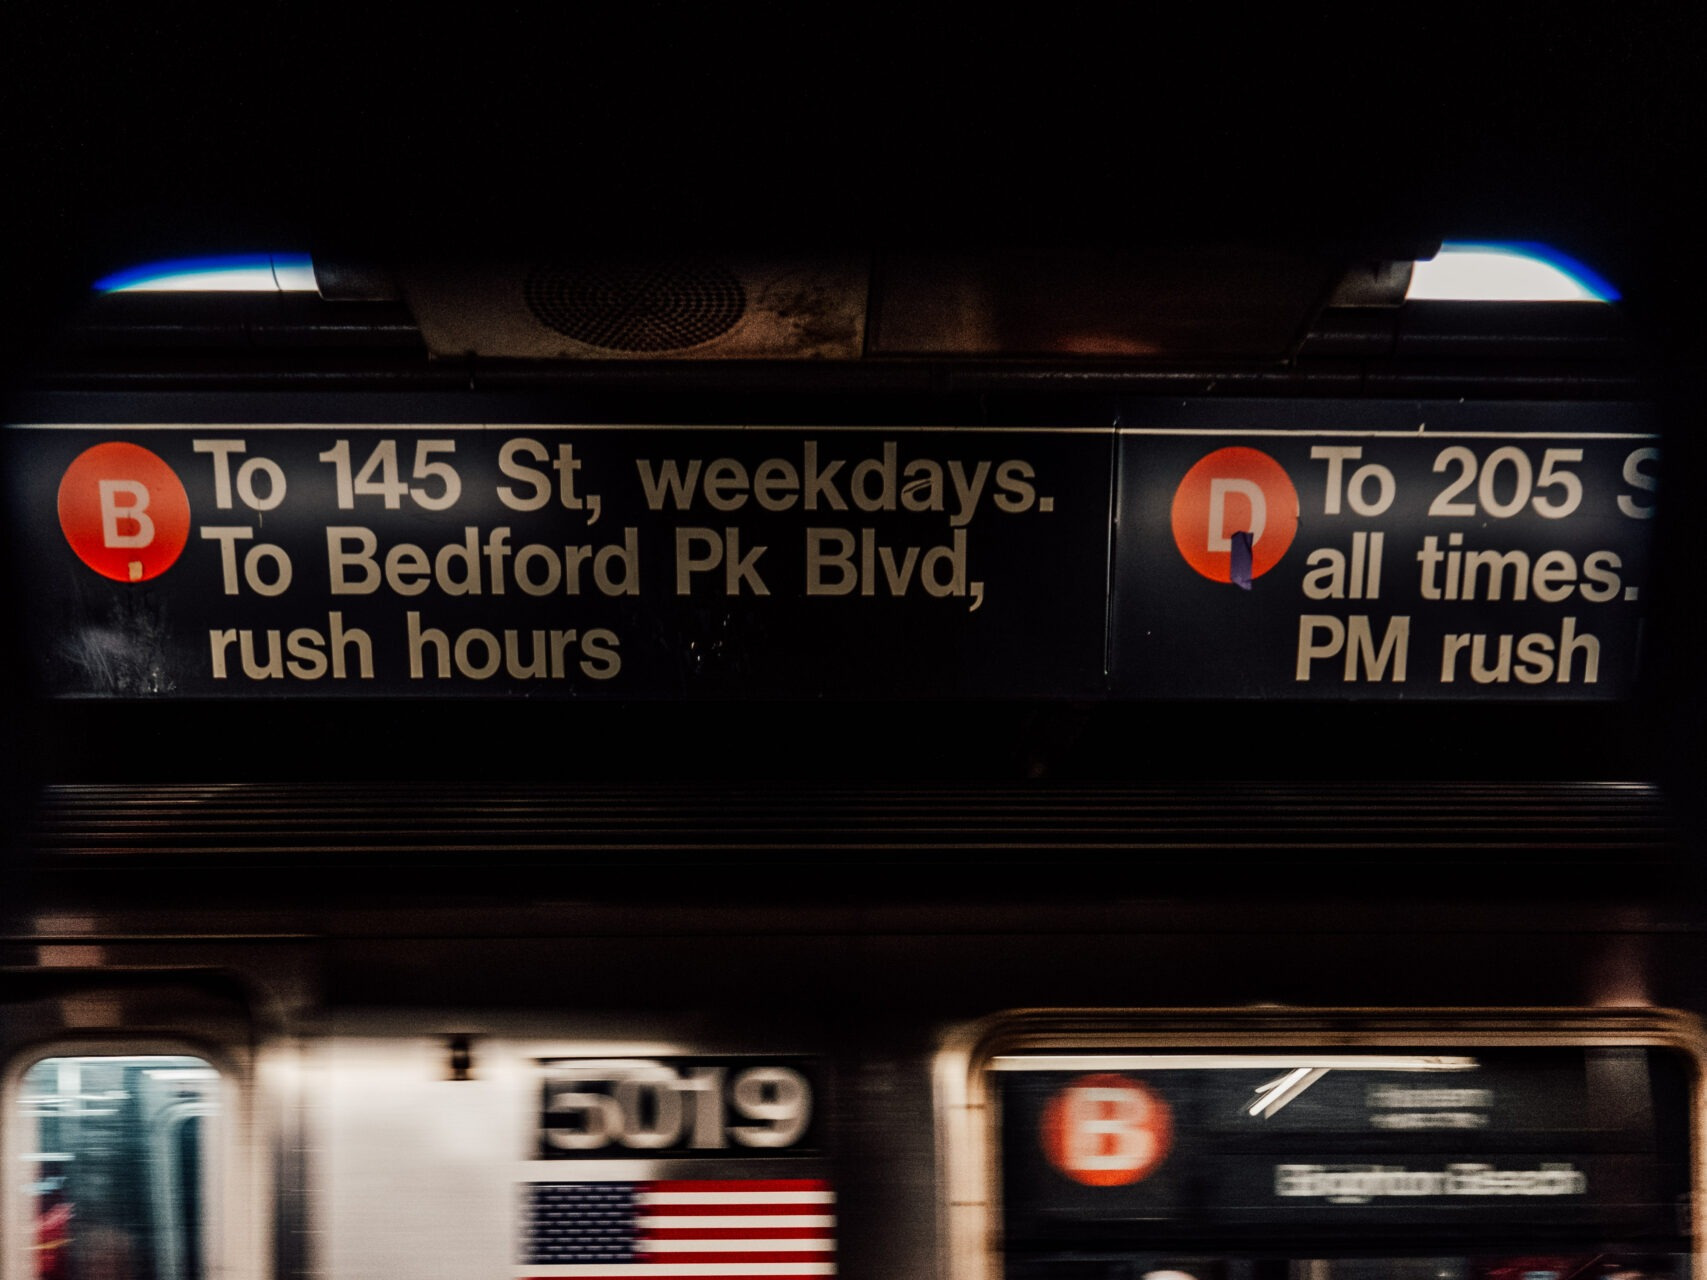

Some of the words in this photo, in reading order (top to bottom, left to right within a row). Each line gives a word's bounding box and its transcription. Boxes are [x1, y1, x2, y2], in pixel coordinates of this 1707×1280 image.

[99, 480, 155, 548] B
[193, 439, 287, 511] To
[319, 439, 462, 511] 145
[496, 438, 601, 526] St,
[636, 440, 1055, 526] weekdays.
[1207, 478, 1267, 552] D
[1310, 446, 1396, 517] To
[1428, 446, 1584, 519] 205
[200, 526, 293, 596] To
[326, 526, 640, 596] Bedford
[675, 527, 771, 596] Pk
[805, 528, 985, 612] Blvd,
[1302, 532, 1384, 600] all
[1417, 533, 1640, 602] times.
[209, 611, 374, 679] rush
[406, 611, 622, 679] hours
[1295, 615, 1410, 681] PM
[1440, 616, 1600, 684] rush
[538, 1060, 813, 1149] 5019
[1063, 1087, 1153, 1170] B
